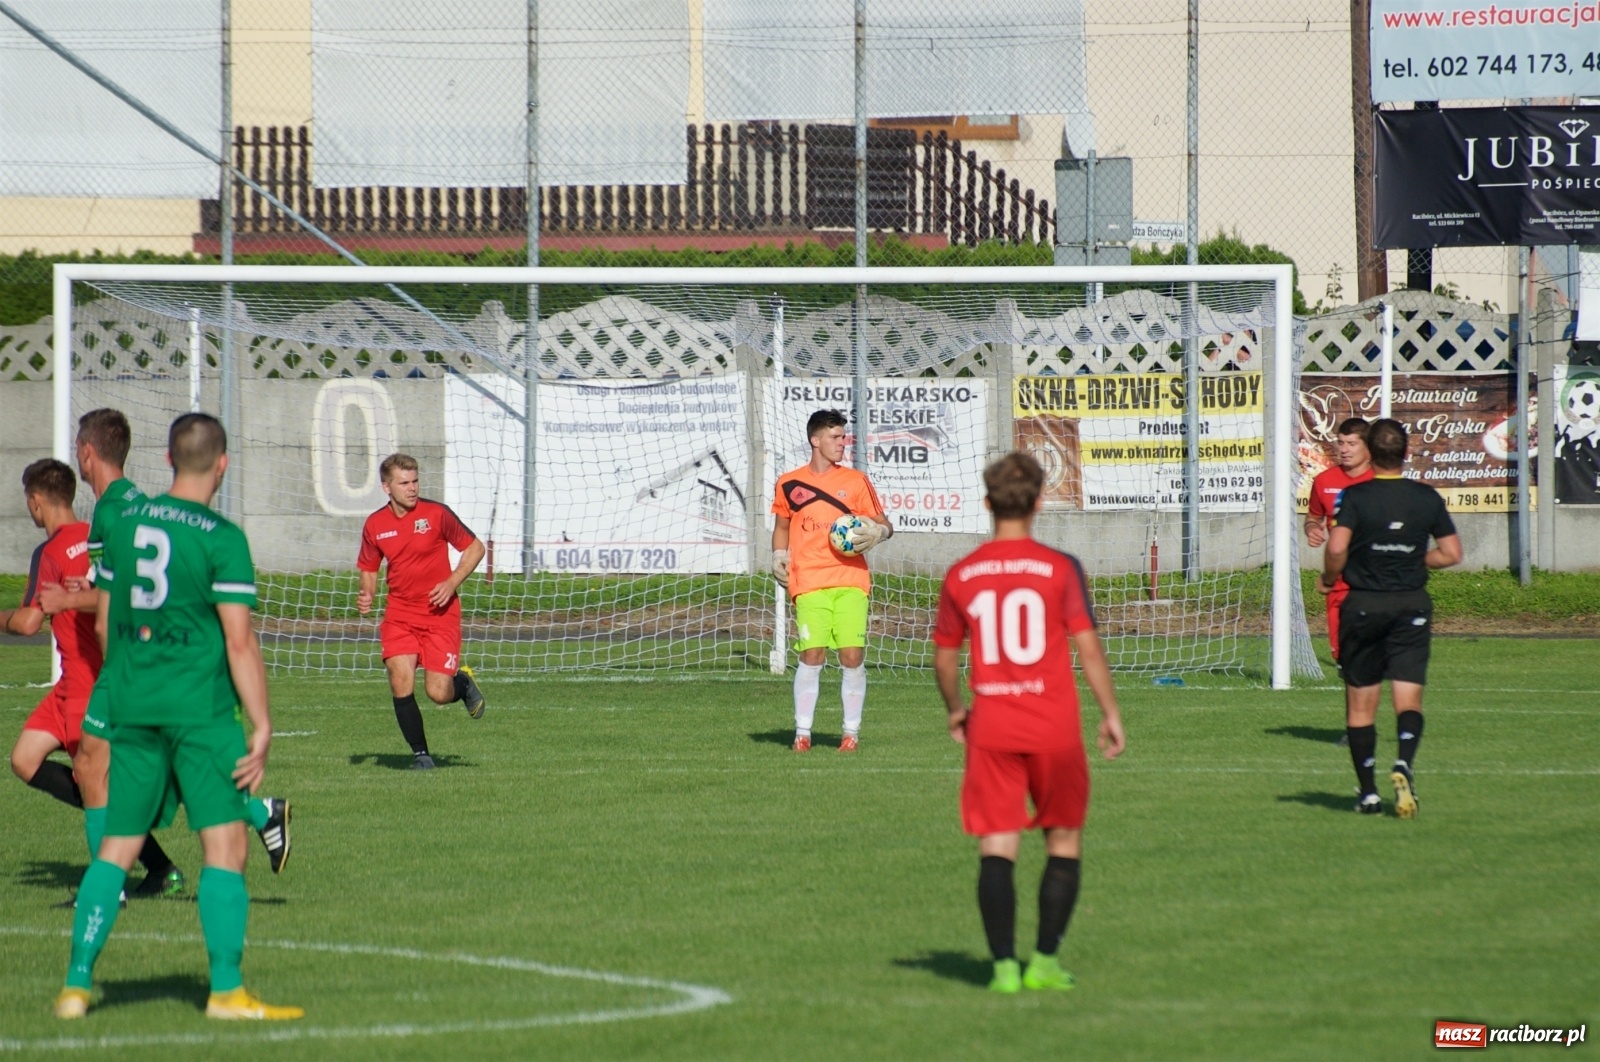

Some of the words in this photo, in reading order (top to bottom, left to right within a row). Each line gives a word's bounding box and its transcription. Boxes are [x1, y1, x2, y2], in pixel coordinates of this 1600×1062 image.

[1384, 1, 1600, 28] www.restauracja
[1383, 58, 1418, 78] tel.
[1427, 56, 1468, 77] 602
[1477, 54, 1517, 75] 744
[1527, 53, 1573, 75] 173,
[1018, 375, 1261, 411] OKNA-DRZWI-SHODY
[1139, 421, 1209, 435] Producnt
[1416, 414, 1486, 443] Gąska
[1091, 443, 1262, 460] www.oknadrzwschody.pl
[1433, 450, 1485, 465] catering
[1424, 464, 1519, 482] okolicznościow
[1208, 477, 1227, 489] 419
[1231, 477, 1245, 488] 62
[1247, 476, 1263, 487] 99
[923, 493, 961, 510] 012
[1161, 494, 1175, 504] ul.
[1251, 492, 1263, 502] 41
[1458, 494, 1478, 506] 798
[1484, 494, 1503, 505] 441
[899, 515, 938, 527] Nowa
[944, 516, 952, 527] 8
[130, 524, 171, 611] 3
[556, 548, 591, 570] 604
[598, 548, 634, 570] 507
[641, 548, 676, 570] 320
[966, 587, 1047, 666] 10
[444, 652, 457, 670] 26
